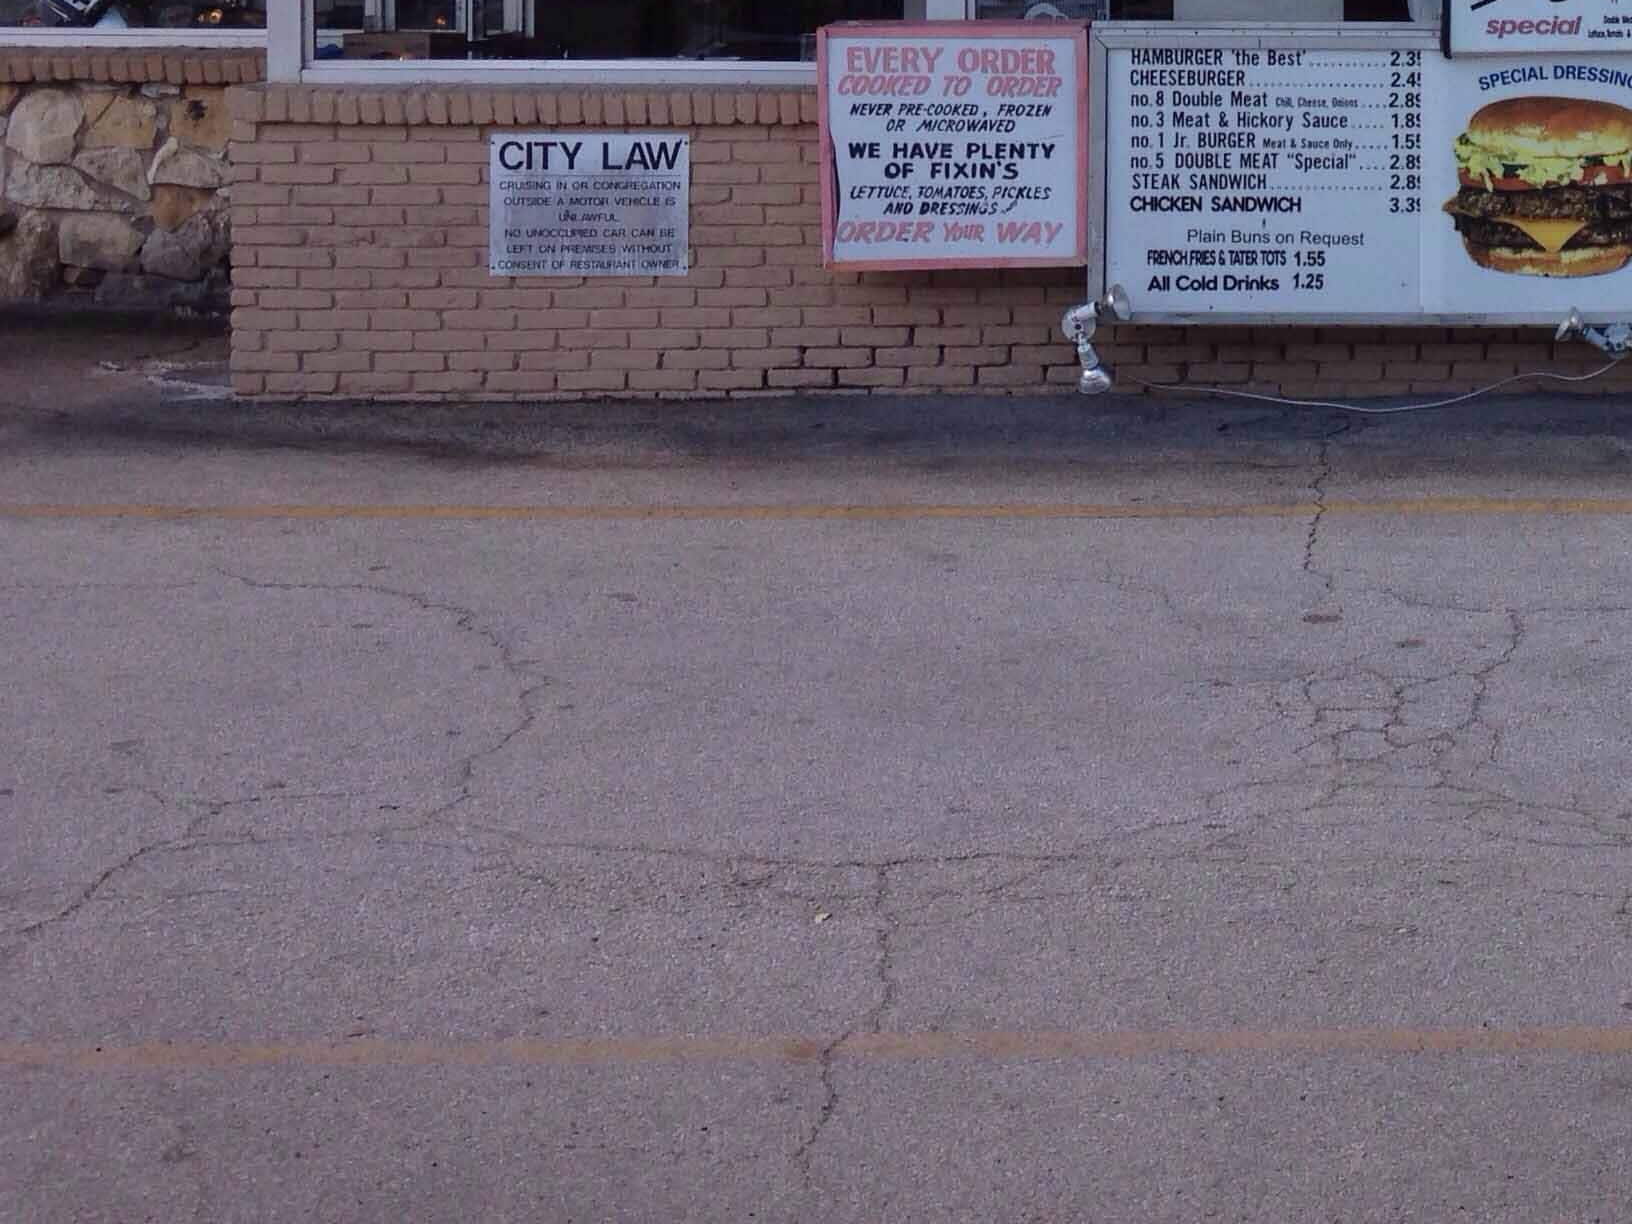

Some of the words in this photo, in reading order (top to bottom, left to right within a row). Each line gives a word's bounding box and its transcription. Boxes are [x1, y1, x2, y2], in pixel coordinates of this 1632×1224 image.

[1486, 16, 1582, 38] special
[847, 46, 943, 73] EVERY
[957, 48, 1055, 75] ORDER
[1132, 49, 1223, 66] HAMBURGER
[838, 75, 930, 96] COOKED
[942, 75, 972, 96] TO
[987, 76, 1062, 98] ORDER
[1130, 70, 1245, 87] CHEESEBURGER
[1478, 66, 1550, 91] SPECIAL
[1173, 91, 1223, 107] Double
[1231, 92, 1268, 107] Meat
[850, 104, 891, 116] NEVER
[998, 104, 1051, 117] FROZEN
[887, 120, 904, 132] OR
[916, 120, 1015, 132] MICROWAVED
[1173, 112, 1210, 128] Meat
[1237, 112, 1293, 131] Hickory
[1302, 112, 1348, 129] Sauce
[1199, 133, 1255, 149] BURGER
[499, 141, 583, 170] CITY
[602, 139, 682, 170] LAW
[849, 143, 880, 158] WE
[893, 143, 954, 158] HAVE
[967, 143, 1055, 159] PLENTY
[1175, 153, 1231, 169] DOUBLE
[1240, 153, 1279, 169] MEAT
[884, 162, 914, 179] OF
[931, 162, 1018, 179] FIXIN'S
[500, 181, 550, 190] CRUISING
[593, 181, 680, 190] CONGREGATION
[1132, 174, 1180, 190] STEAK
[1190, 174, 1267, 190] SANDWICH
[851, 186, 912, 200] LETTUCE,
[918, 186, 988, 200] TOMATOES,
[993, 187, 1051, 200] PICKLES
[504, 197, 552, 206] OUTSIDE
[569, 197, 609, 206] MOTOR
[614, 197, 660, 206] VEHICLE
[884, 202, 913, 215] AND
[920, 202, 997, 215] DRESSINGS
[1130, 196, 1202, 212] CHICKEN
[1211, 196, 1301, 212] SANDWICH
[526, 229, 597, 238] UNOCCUPIED
[603, 229, 625, 238] CAR
[631, 229, 654, 238] CAN
[839, 222, 934, 243] ORDER
[998, 223, 1061, 243] WAY
[1187, 229, 1226, 244] Plain
[1232, 230, 1270, 244] Buns
[1275, 233, 1294, 245] on
[1300, 231, 1364, 247] Request
[507, 244, 532, 254] LEFT
[560, 244, 616, 254] PREMISES
[622, 244, 672, 254] WITHOUT
[498, 260, 546, 270] CONSENT
[570, 260, 636, 270] RESTAURANT
[1147, 250, 1187, 266] FRENCH
[1229, 250, 1259, 266] TATER
[1261, 250, 1286, 266] TOTS
[1294, 250, 1326, 266] 1.55
[1148, 275, 1170, 291] All
[1175, 276, 1218, 291] Cold
[1224, 275, 1279, 291] Drinks
[1293, 273, 1324, 290] 1.25
